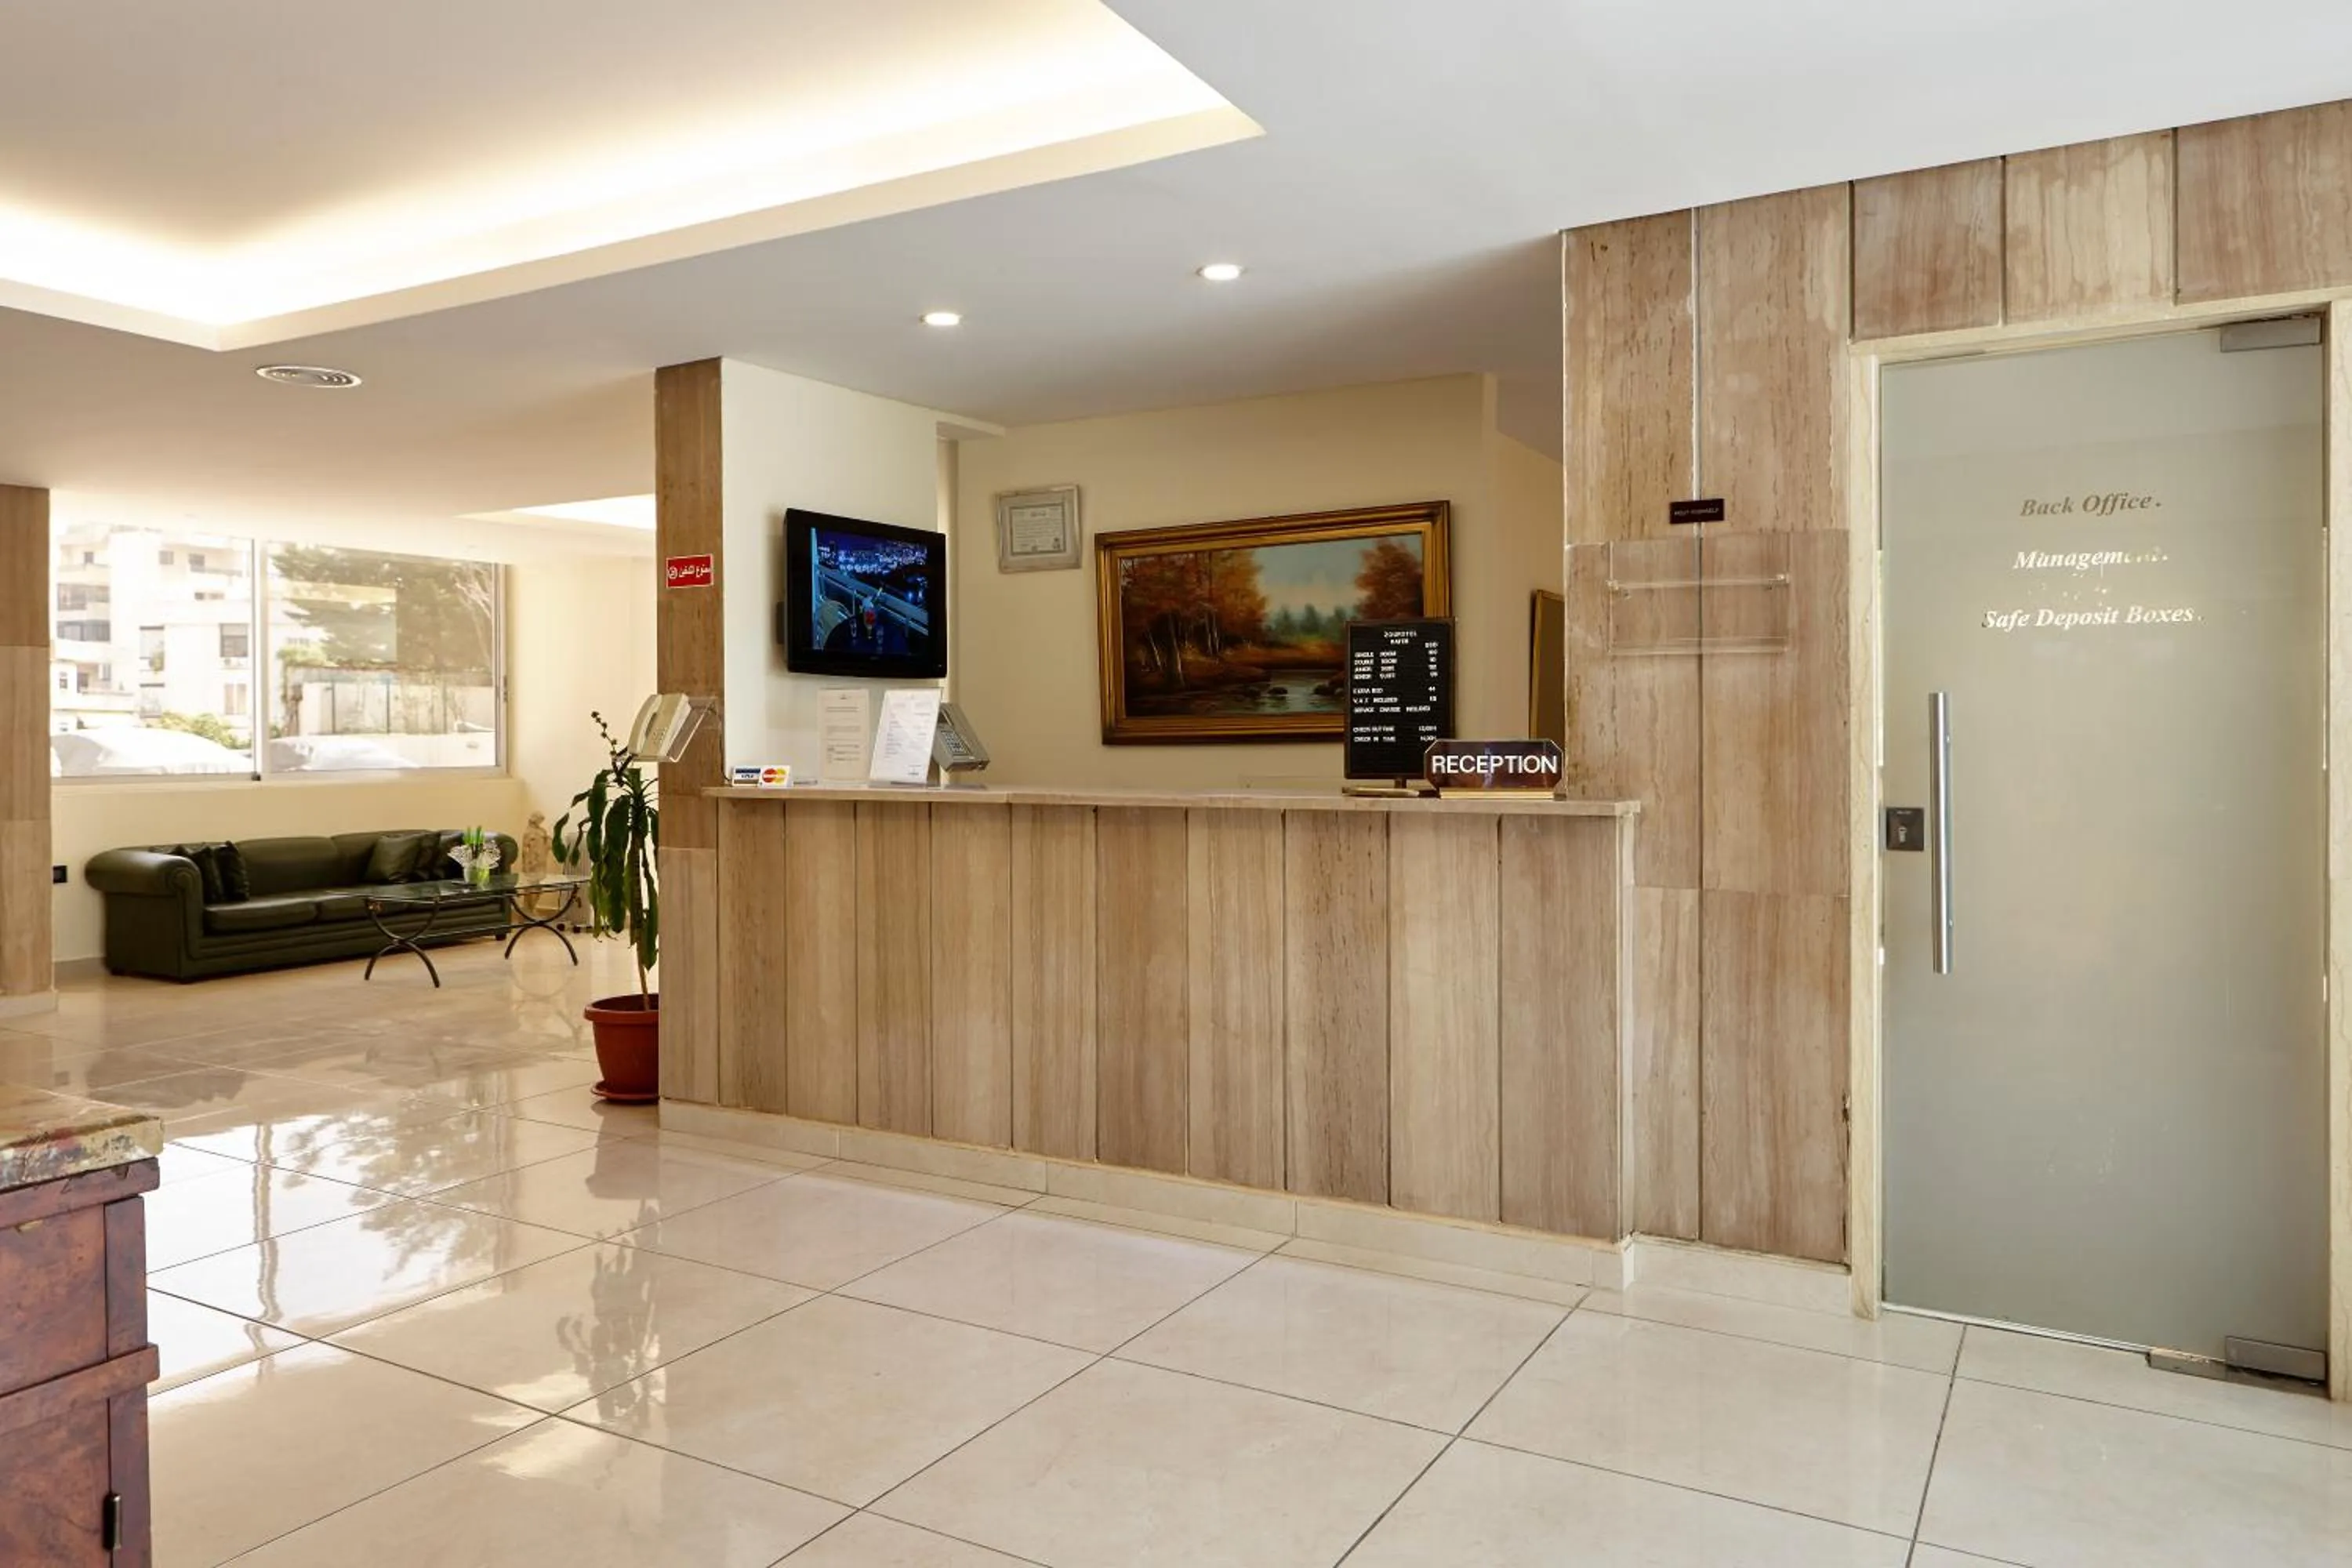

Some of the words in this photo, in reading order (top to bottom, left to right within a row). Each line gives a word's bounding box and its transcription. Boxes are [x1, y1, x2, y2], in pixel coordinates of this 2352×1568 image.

[2020, 496, 2075, 516] Back
[2082, 492, 2162, 516] Office.
[1982, 608, 2031, 633] Safe
[2034, 607, 2120, 631] Deposit
[2124, 604, 2207, 626] Boxes.
[1432, 755, 1558, 774] RECEPTION
